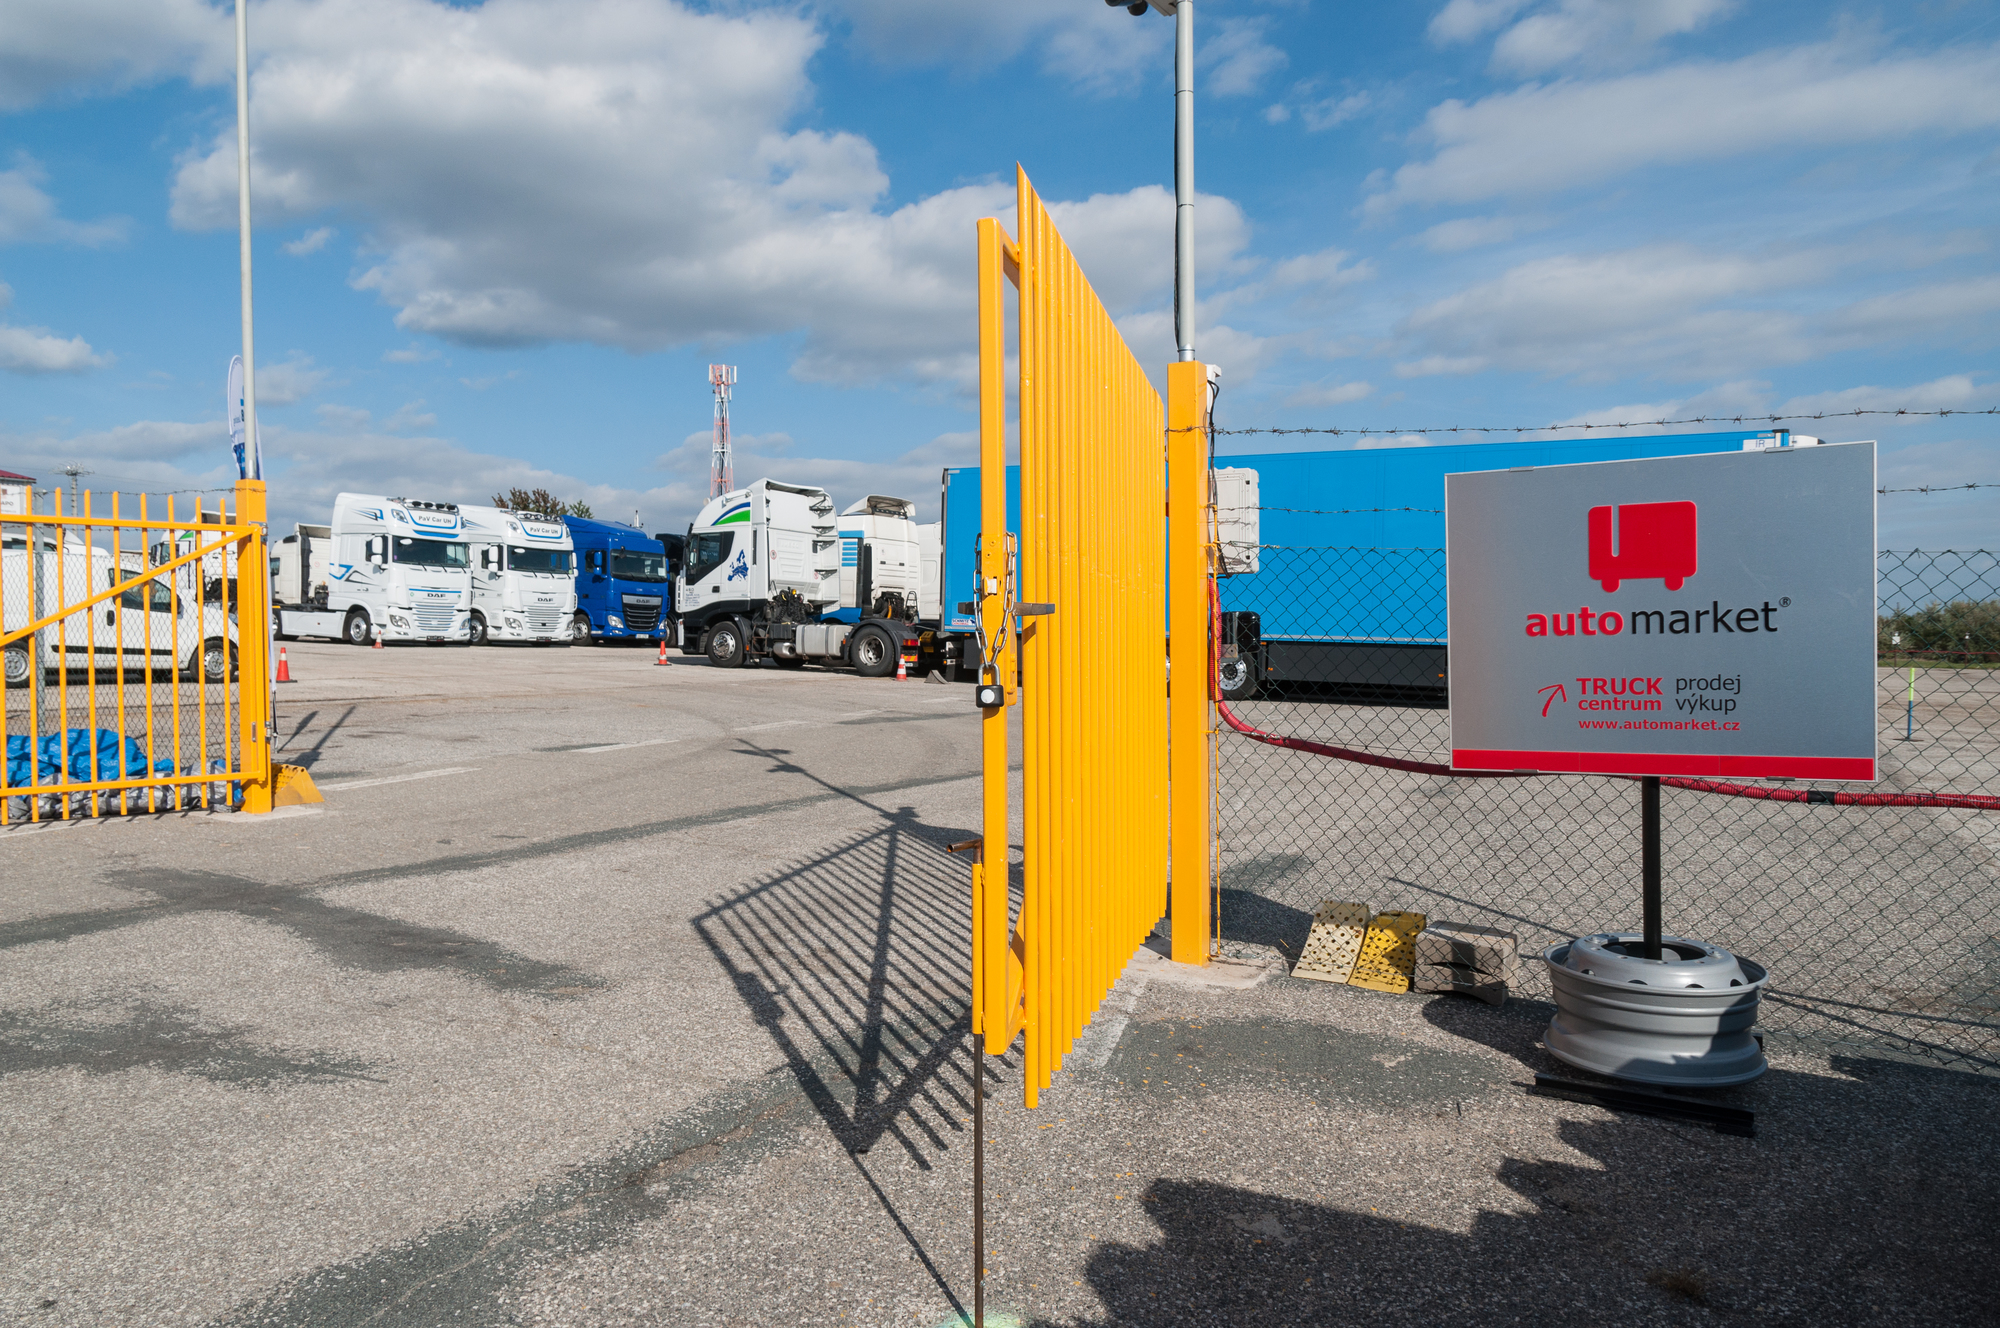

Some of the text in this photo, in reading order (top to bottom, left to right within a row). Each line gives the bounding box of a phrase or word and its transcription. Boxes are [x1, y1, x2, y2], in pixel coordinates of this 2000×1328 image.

[1576, 677, 1664, 695] TRUCK
[1676, 674, 1741, 695] prodej
[1578, 696, 1662, 711] centrum
[1675, 693, 1737, 715] výkup
[1578, 718, 1741, 731] www.automarket.cz
